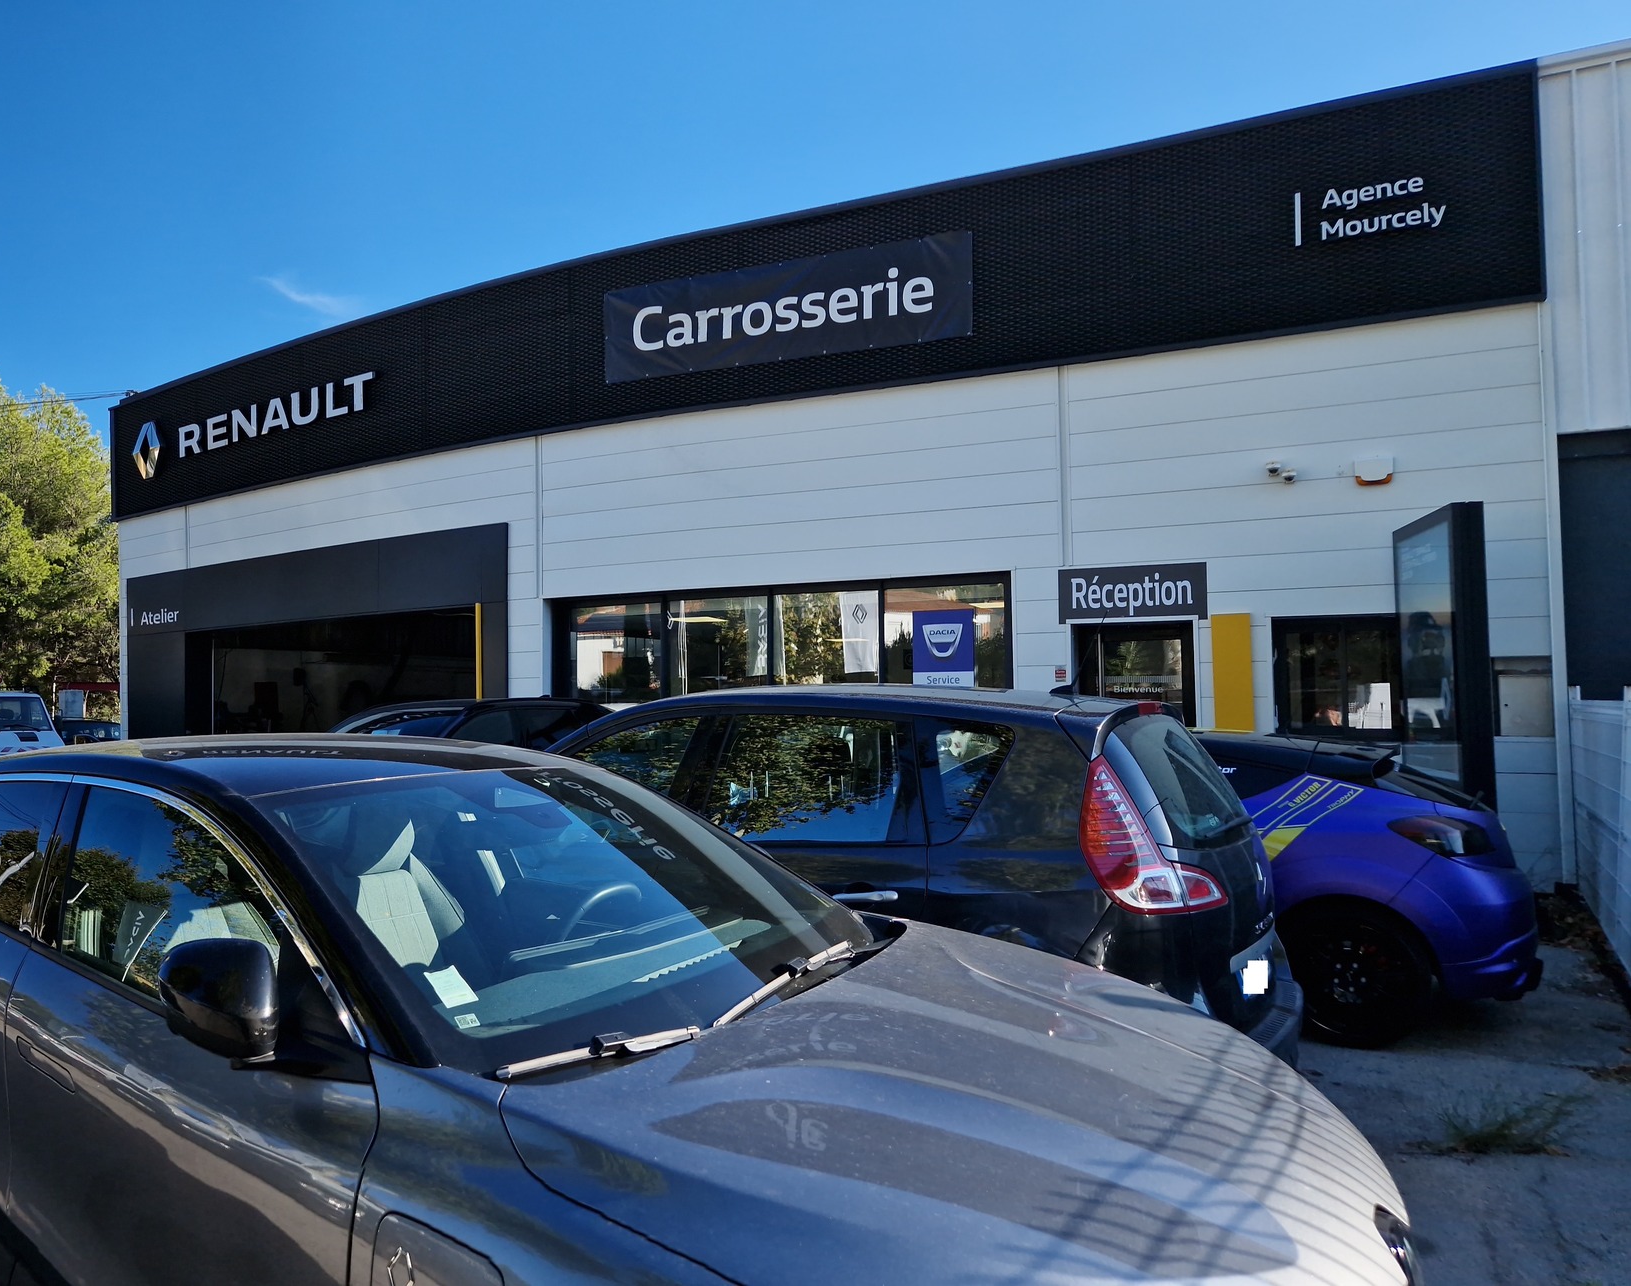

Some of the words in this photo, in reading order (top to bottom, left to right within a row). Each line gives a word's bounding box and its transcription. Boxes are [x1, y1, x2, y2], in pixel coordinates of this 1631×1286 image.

[1322, 177, 1424, 210] Agence
[1320, 202, 1447, 241] Mourcely
[632, 267, 935, 351] Carrosserie
[178, 371, 376, 458] RENAULT
[1070, 572, 1193, 616] Réception
[140, 608, 179, 626] Atelier
[926, 675, 960, 685] Service
[1113, 685, 1164, 693] Bienvenue
